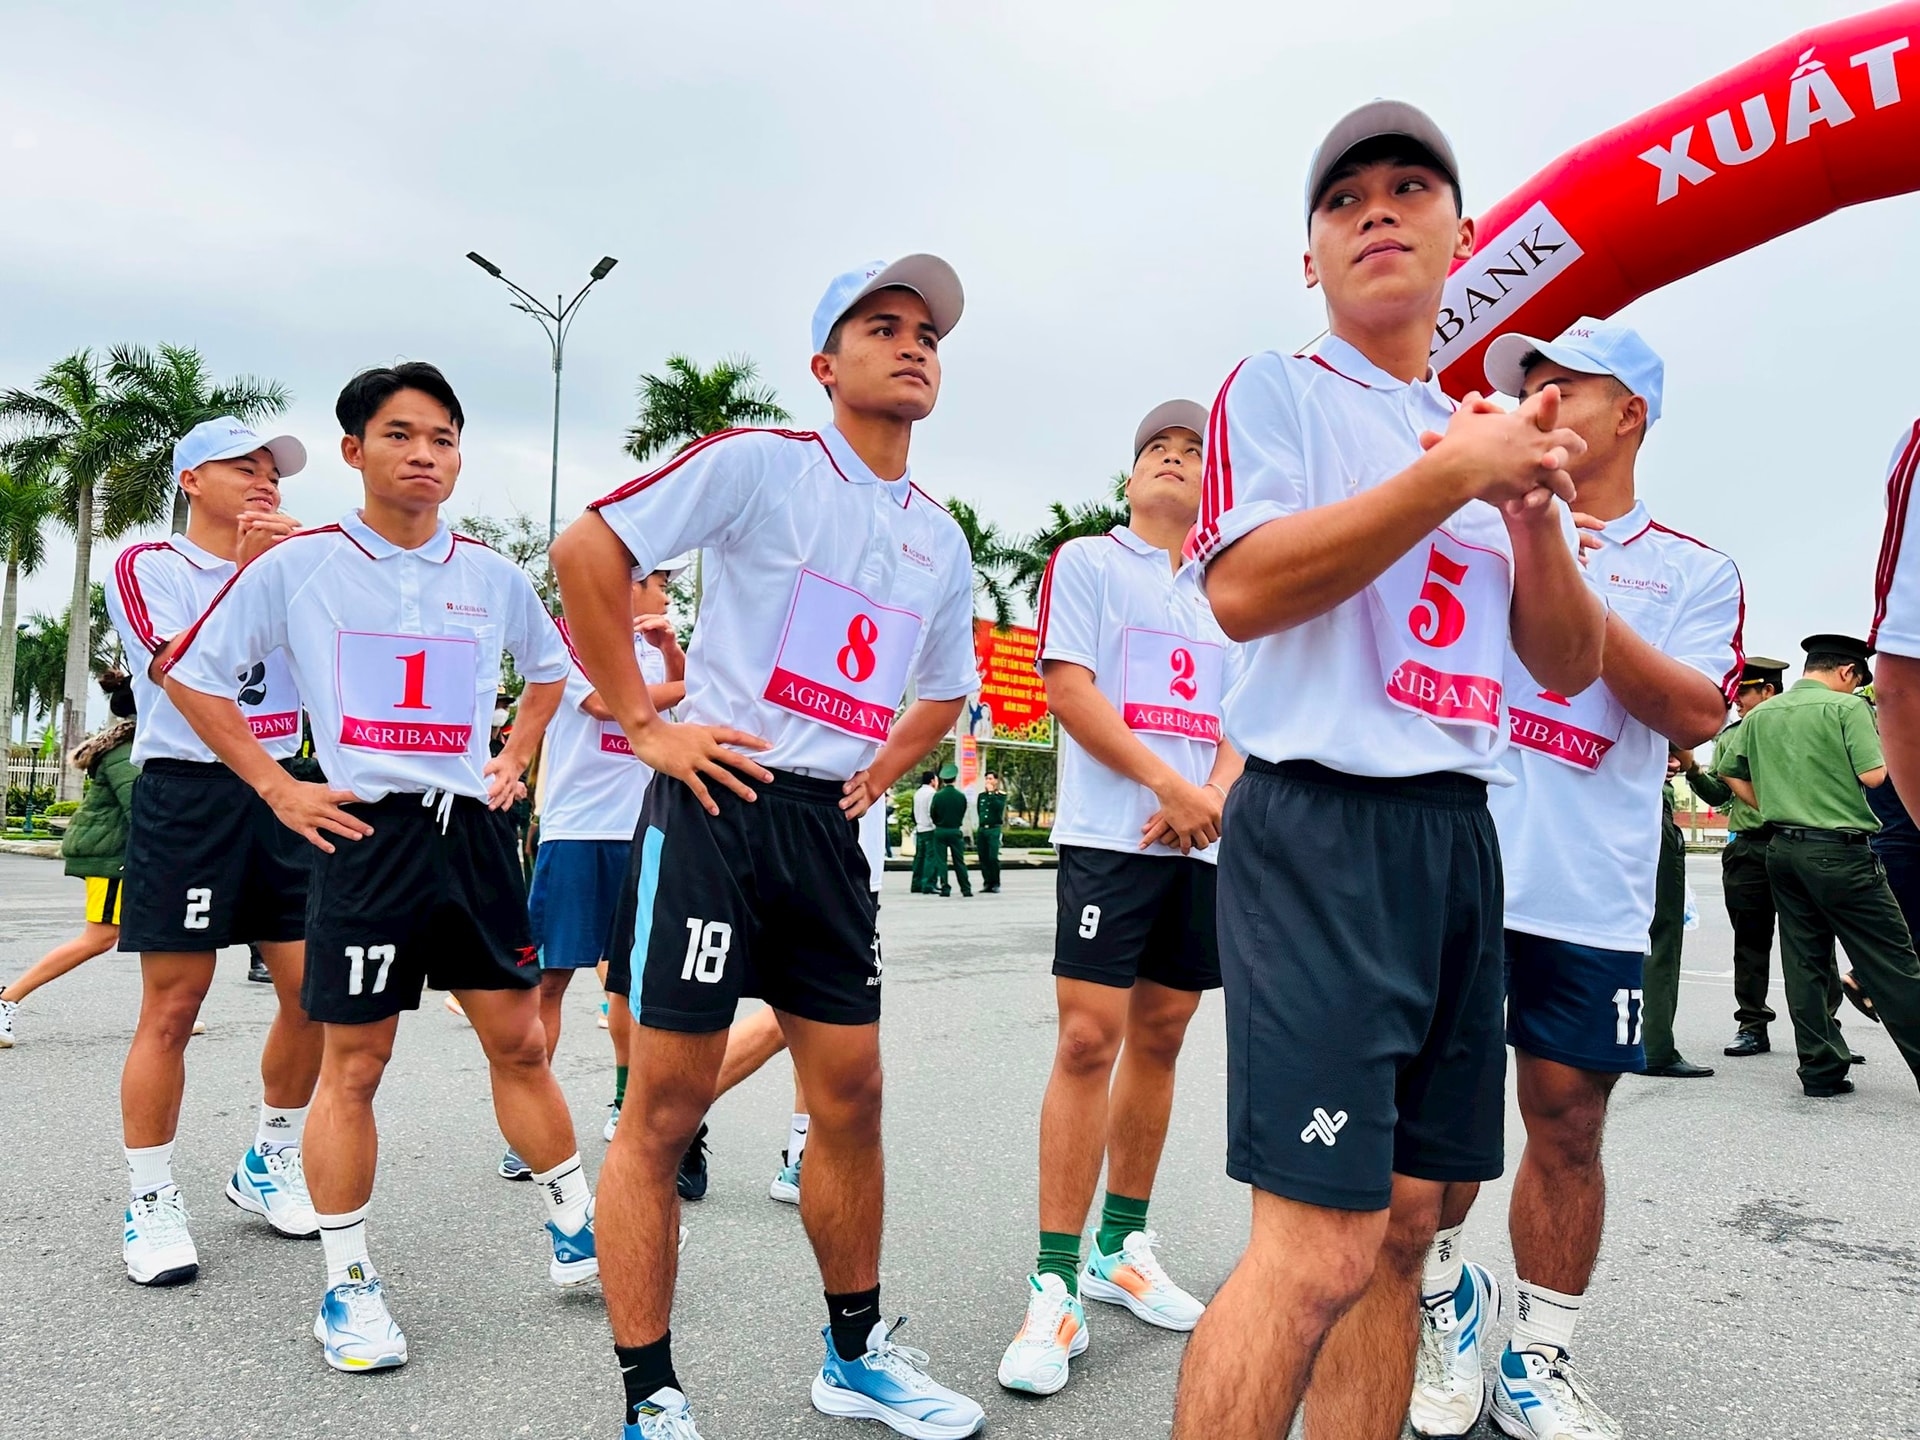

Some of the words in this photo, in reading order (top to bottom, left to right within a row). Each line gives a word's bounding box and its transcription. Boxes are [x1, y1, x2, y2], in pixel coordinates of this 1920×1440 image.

[1637, 36, 1910, 205] XUẤT
[1429, 223, 1567, 357] BANK
[1408, 542, 1470, 649] 5
[836, 613, 879, 683] 8
[1169, 647, 1198, 702] 2
[237, 661, 267, 706] 2
[393, 650, 432, 709] 1
[352, 724, 467, 747] AGRIBANK
[606, 739, 632, 751] AG
[184, 888, 212, 930] 2
[1079, 904, 1101, 940] 9
[345, 944, 396, 995] 17
[681, 917, 733, 984] 18
[1612, 988, 1645, 1046] 17
